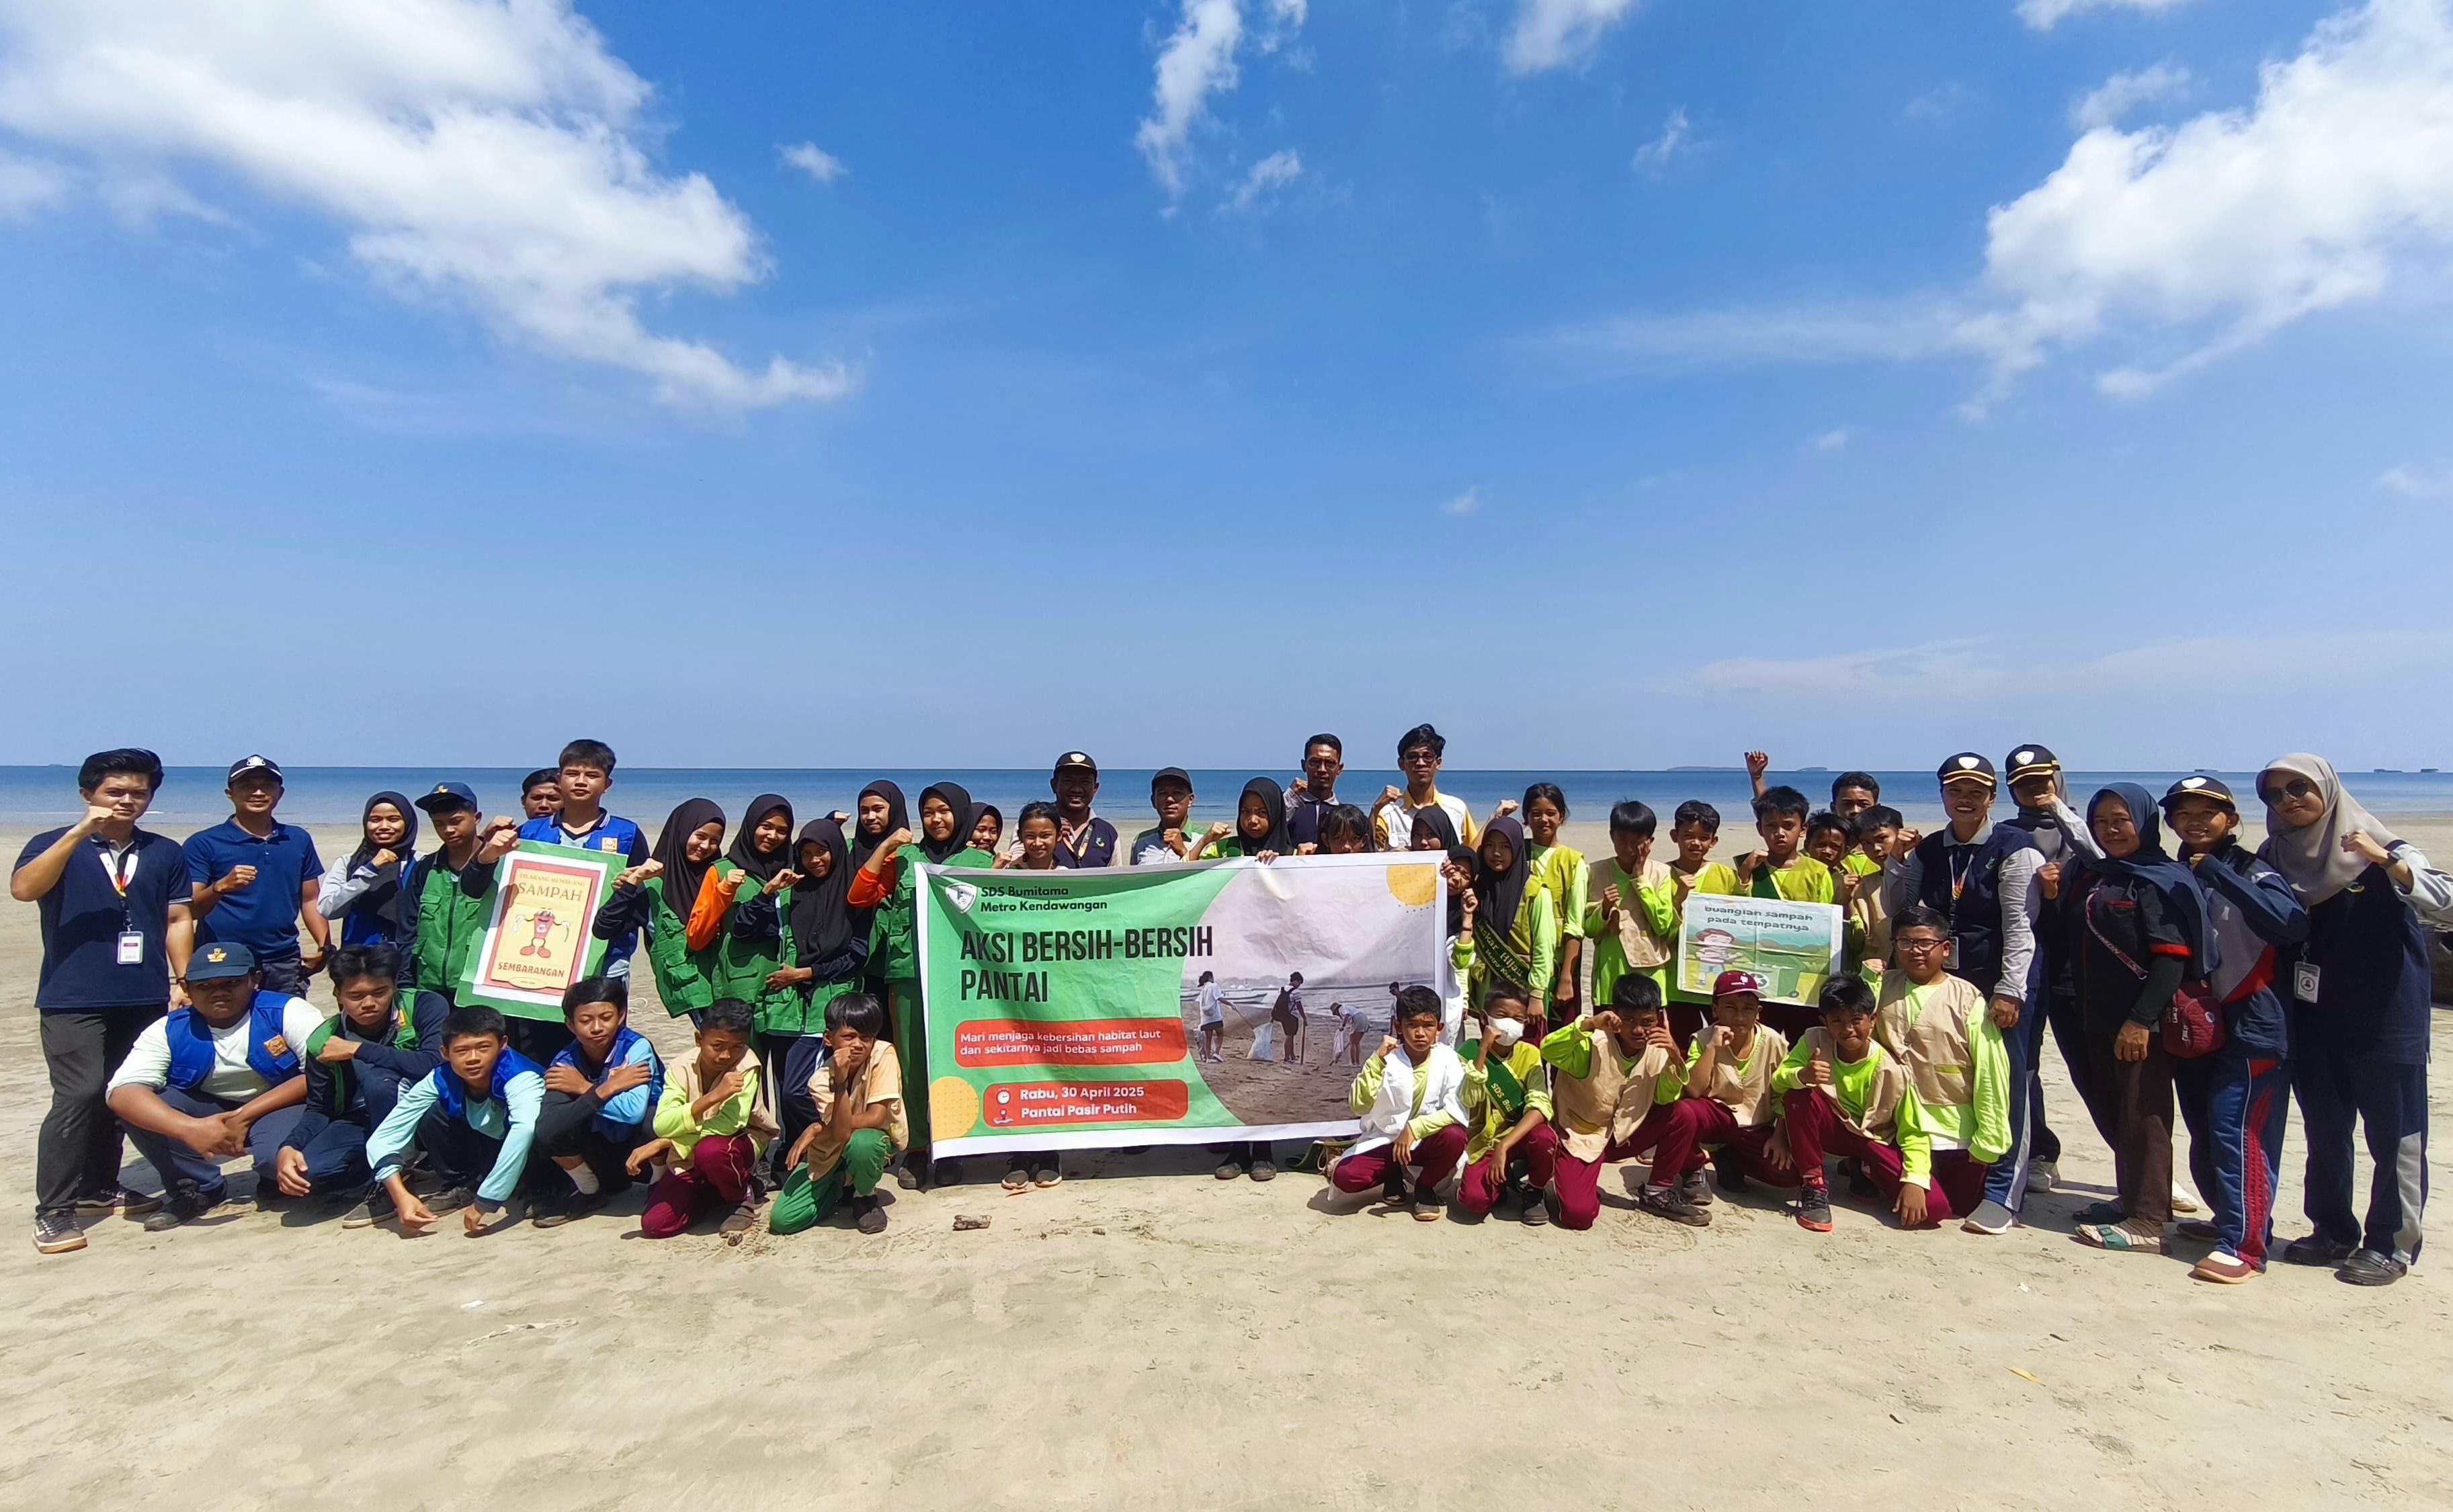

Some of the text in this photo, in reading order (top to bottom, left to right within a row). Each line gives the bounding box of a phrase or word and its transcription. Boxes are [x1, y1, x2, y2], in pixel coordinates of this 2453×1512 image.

[519, 882, 582, 901] SAMPAH
[981, 886, 1069, 897] SDS Bumitama
[981, 900, 1108, 913] Metro Kendawangan
[1765, 911, 1813, 921] sampah
[1741, 919, 1809, 932] tempatnya
[960, 925, 1213, 963] AKSI BERSIH-BERSIH
[498, 962, 565, 978] SEMBARANGAN
[960, 969, 1048, 1003] PANTAI
[960, 1030, 1161, 1042] Mari menjaga kebersihan habitat laut
[960, 1042, 1142, 1055] dan sekitarnya jadi bebas sampah
[1020, 1086, 1144, 1101] Rabu, 30 April 2025
[1491, 1083, 1505, 1099] SDS
[1022, 1102, 1137, 1118] Pantai Pasir Putih
